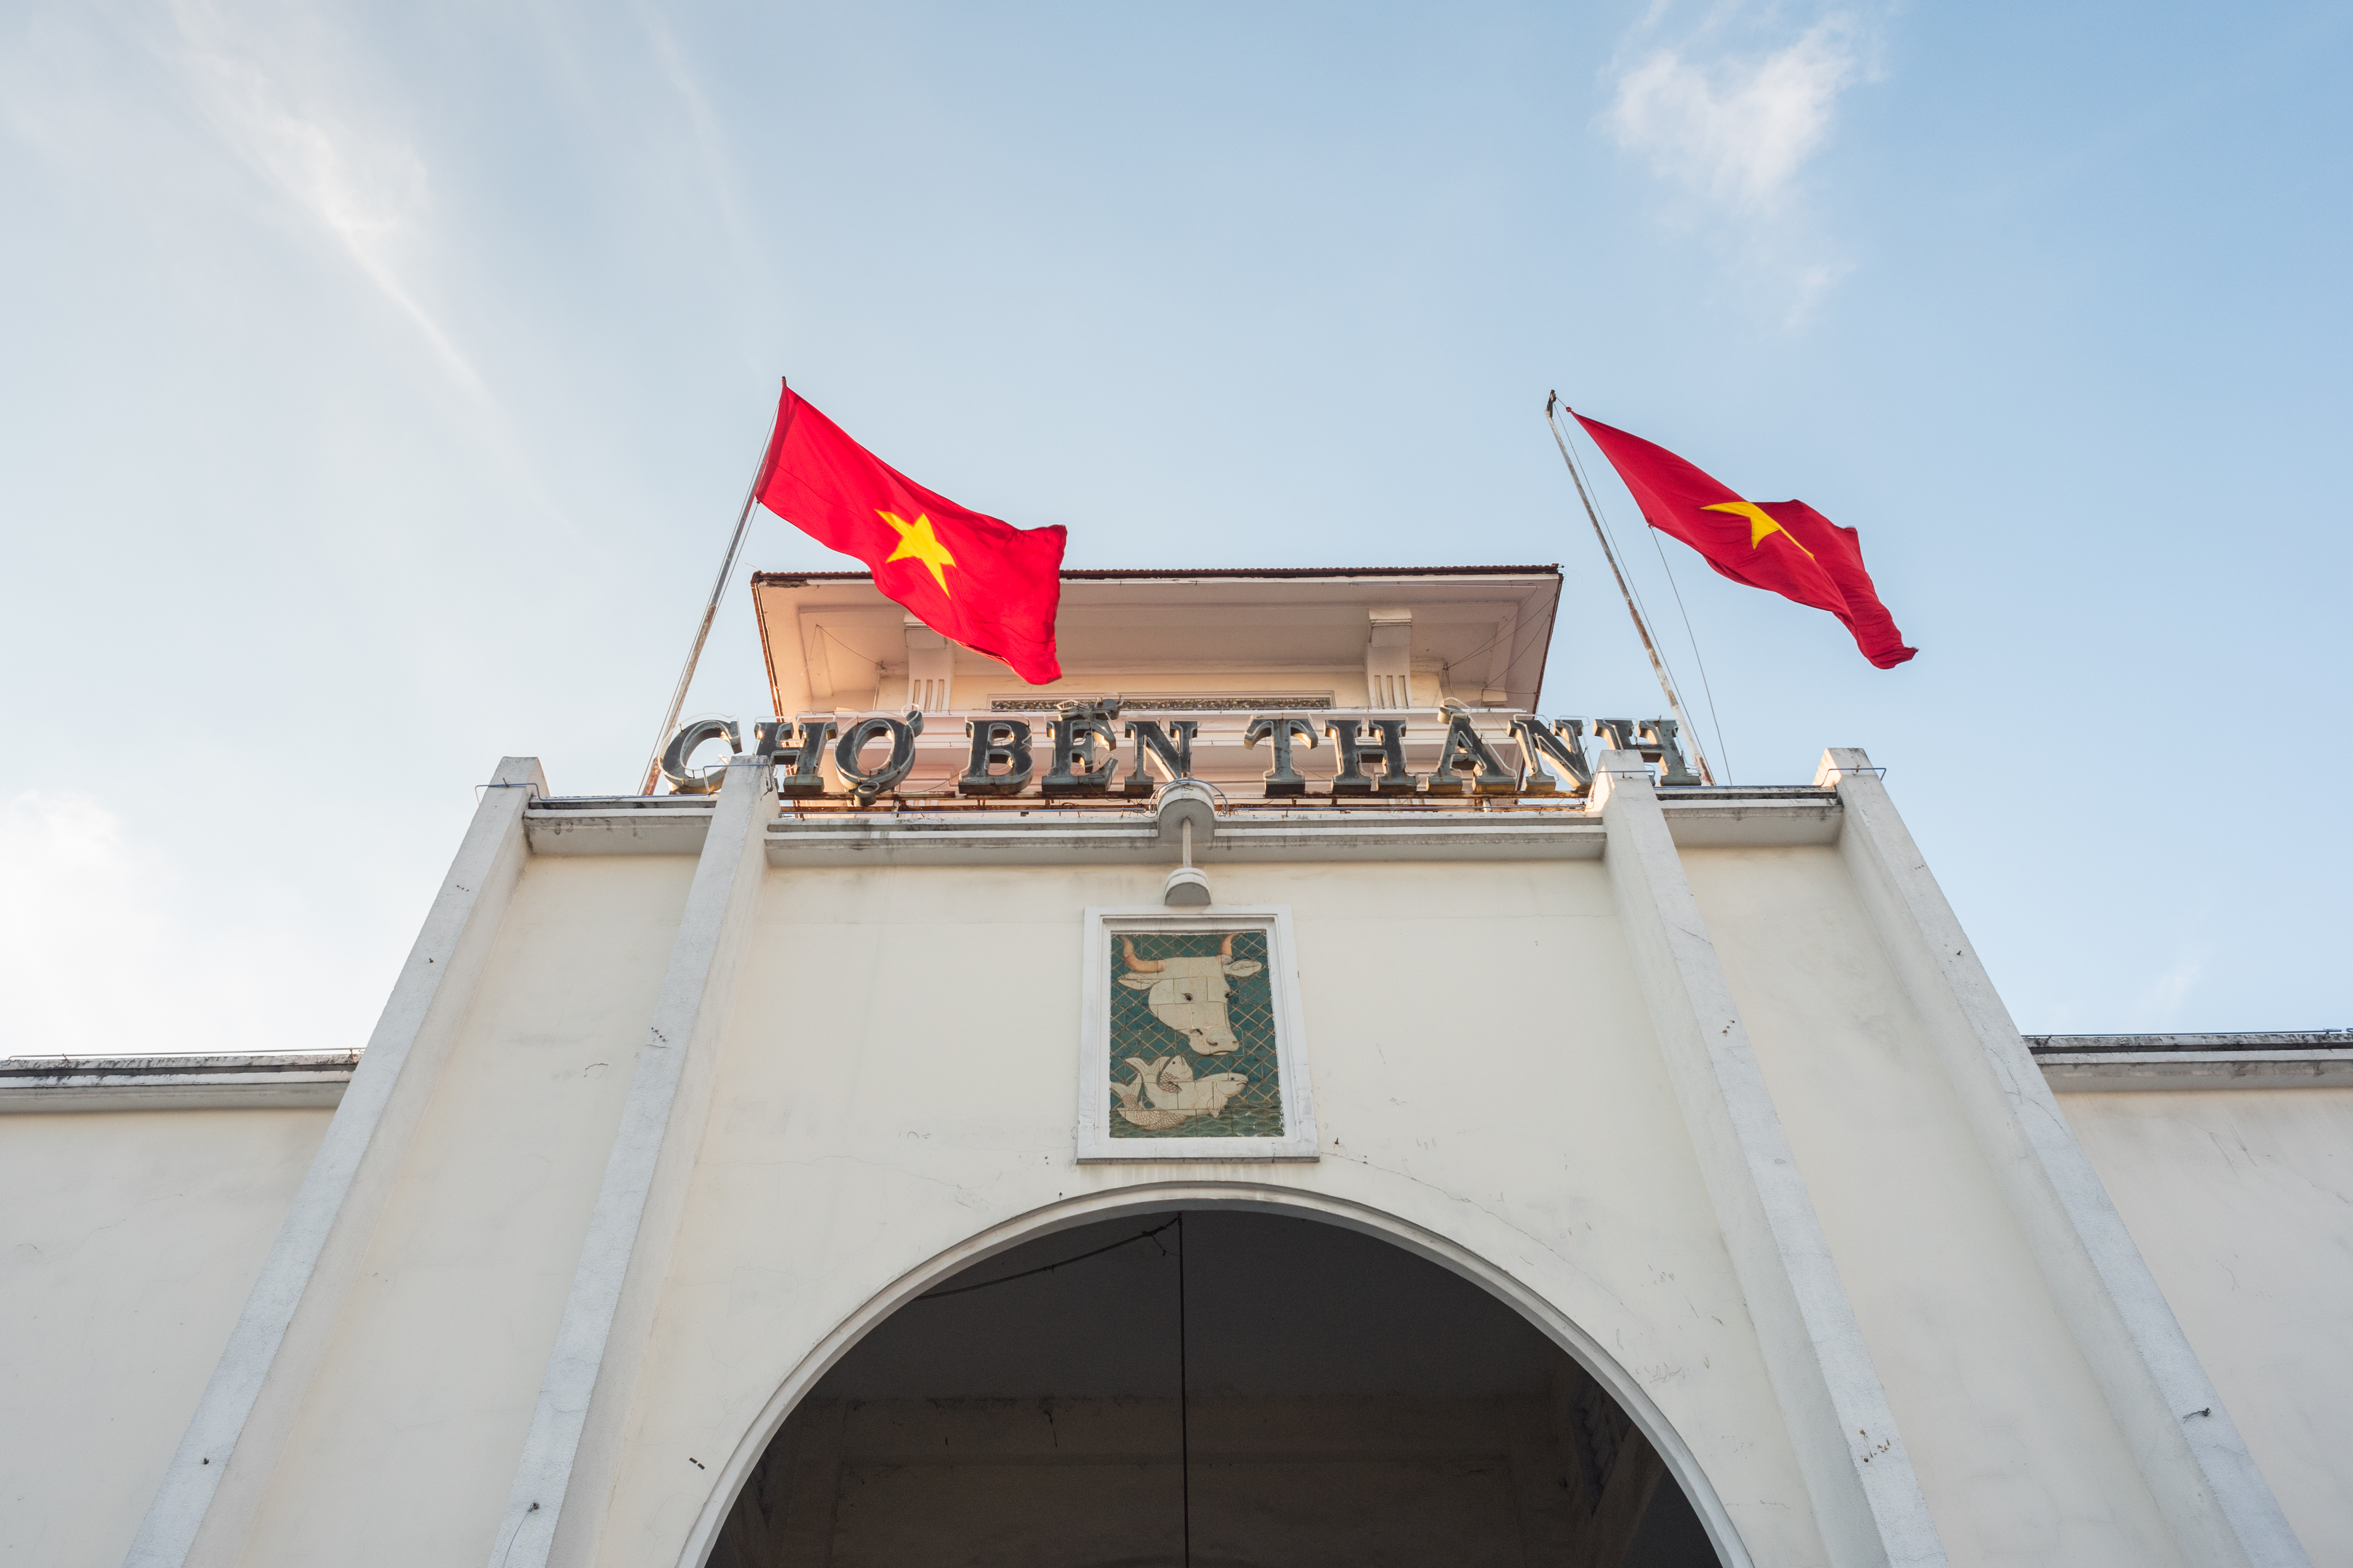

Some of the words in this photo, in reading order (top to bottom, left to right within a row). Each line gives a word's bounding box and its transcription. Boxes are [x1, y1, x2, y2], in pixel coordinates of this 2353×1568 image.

[659, 706, 923, 806] CHỢ
[958, 693, 1201, 794] BẾN
[1244, 698, 1701, 795] THÀNH
